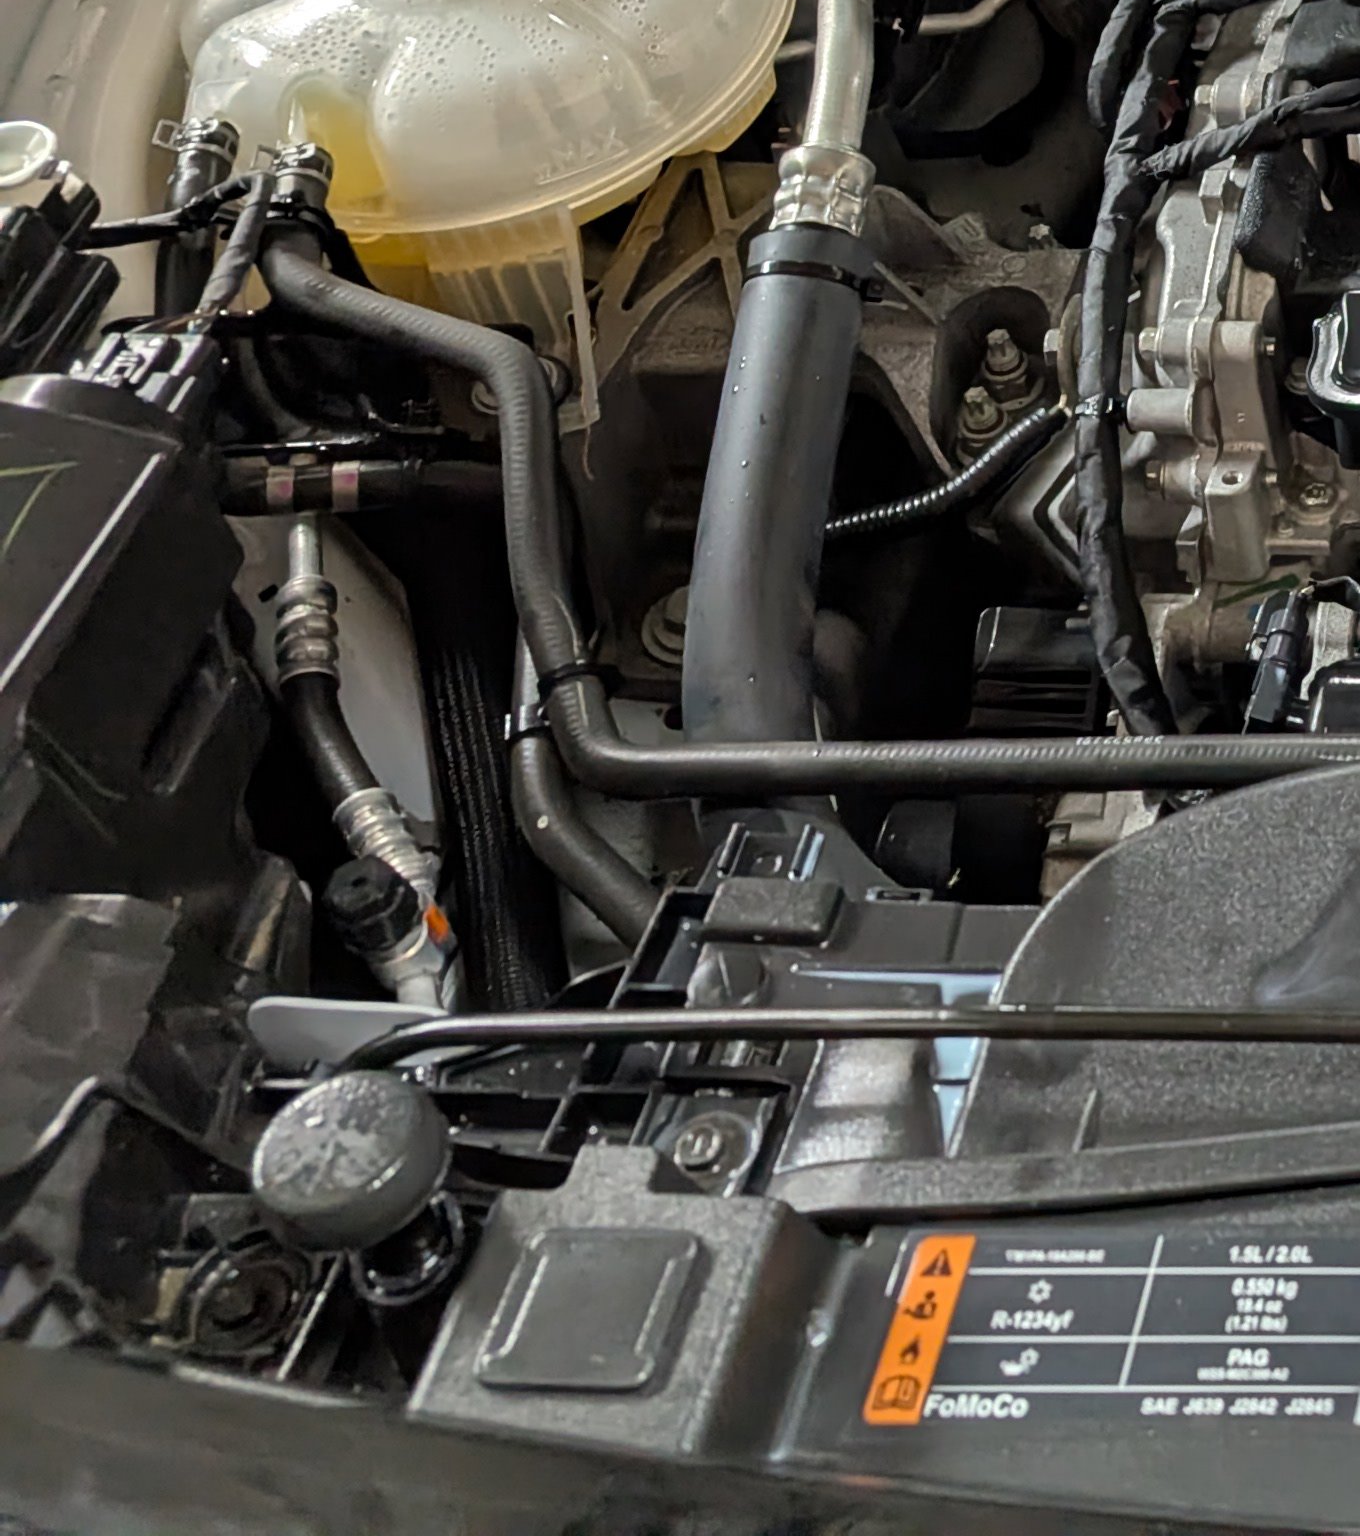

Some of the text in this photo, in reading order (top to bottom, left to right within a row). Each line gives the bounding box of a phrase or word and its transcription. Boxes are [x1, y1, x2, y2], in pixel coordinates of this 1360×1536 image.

[1226, 1348, 1270, 1366] PAG
[923, 1393, 1030, 1419] FoMoCo
[1140, 1397, 1180, 1415] SAE
